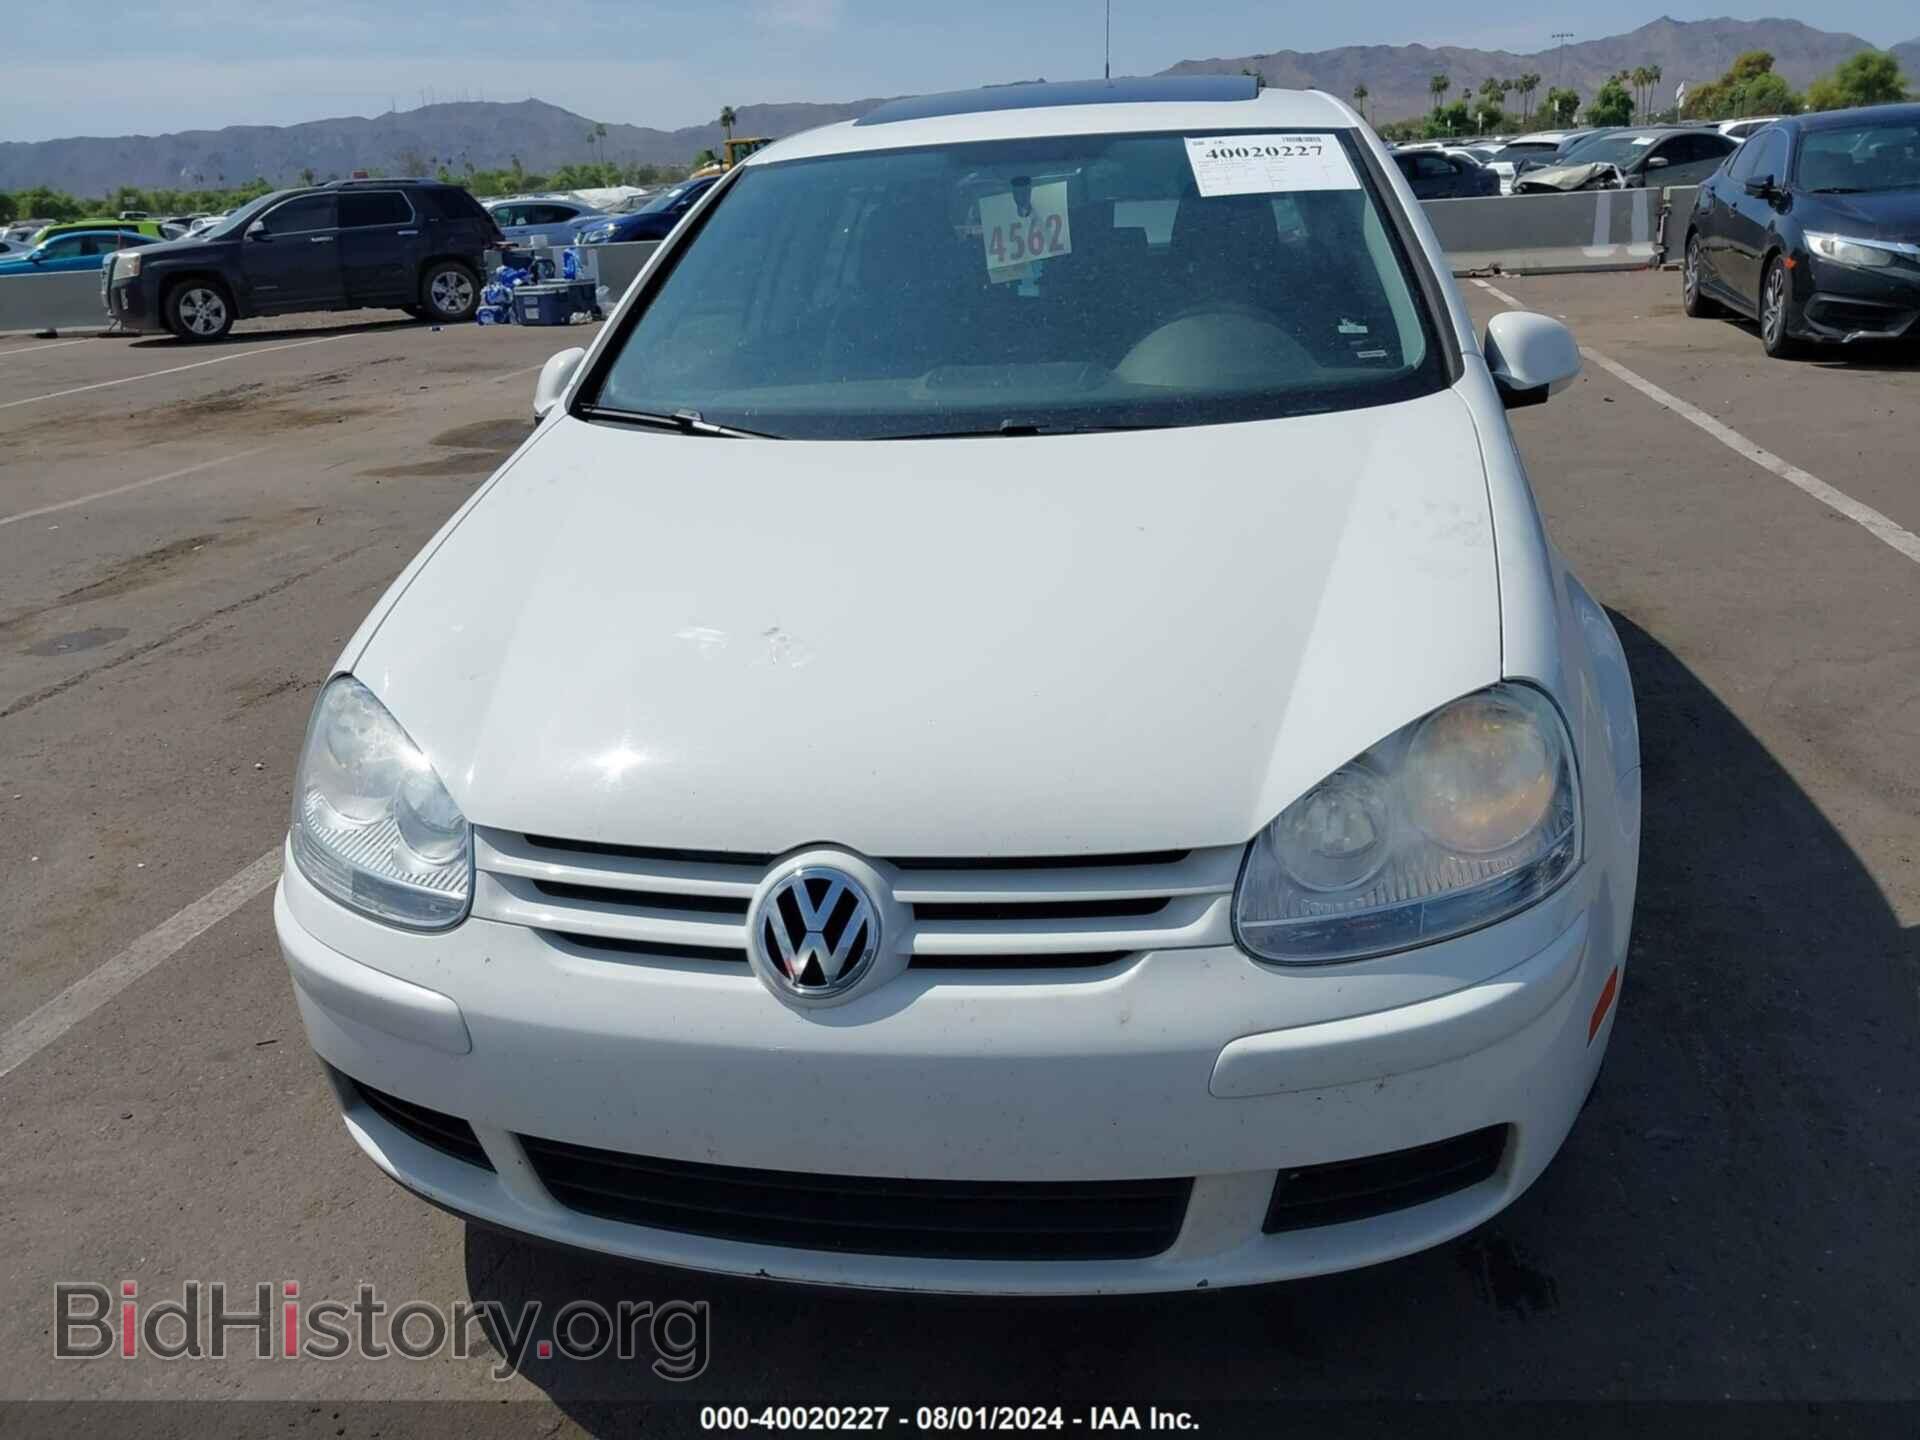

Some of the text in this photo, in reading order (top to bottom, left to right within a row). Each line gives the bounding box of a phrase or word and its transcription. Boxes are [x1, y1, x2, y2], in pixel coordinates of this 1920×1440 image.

[1205, 145, 1323, 160] 40020227
[989, 213, 1064, 263] 4562
[763, 876, 870, 987] VW
